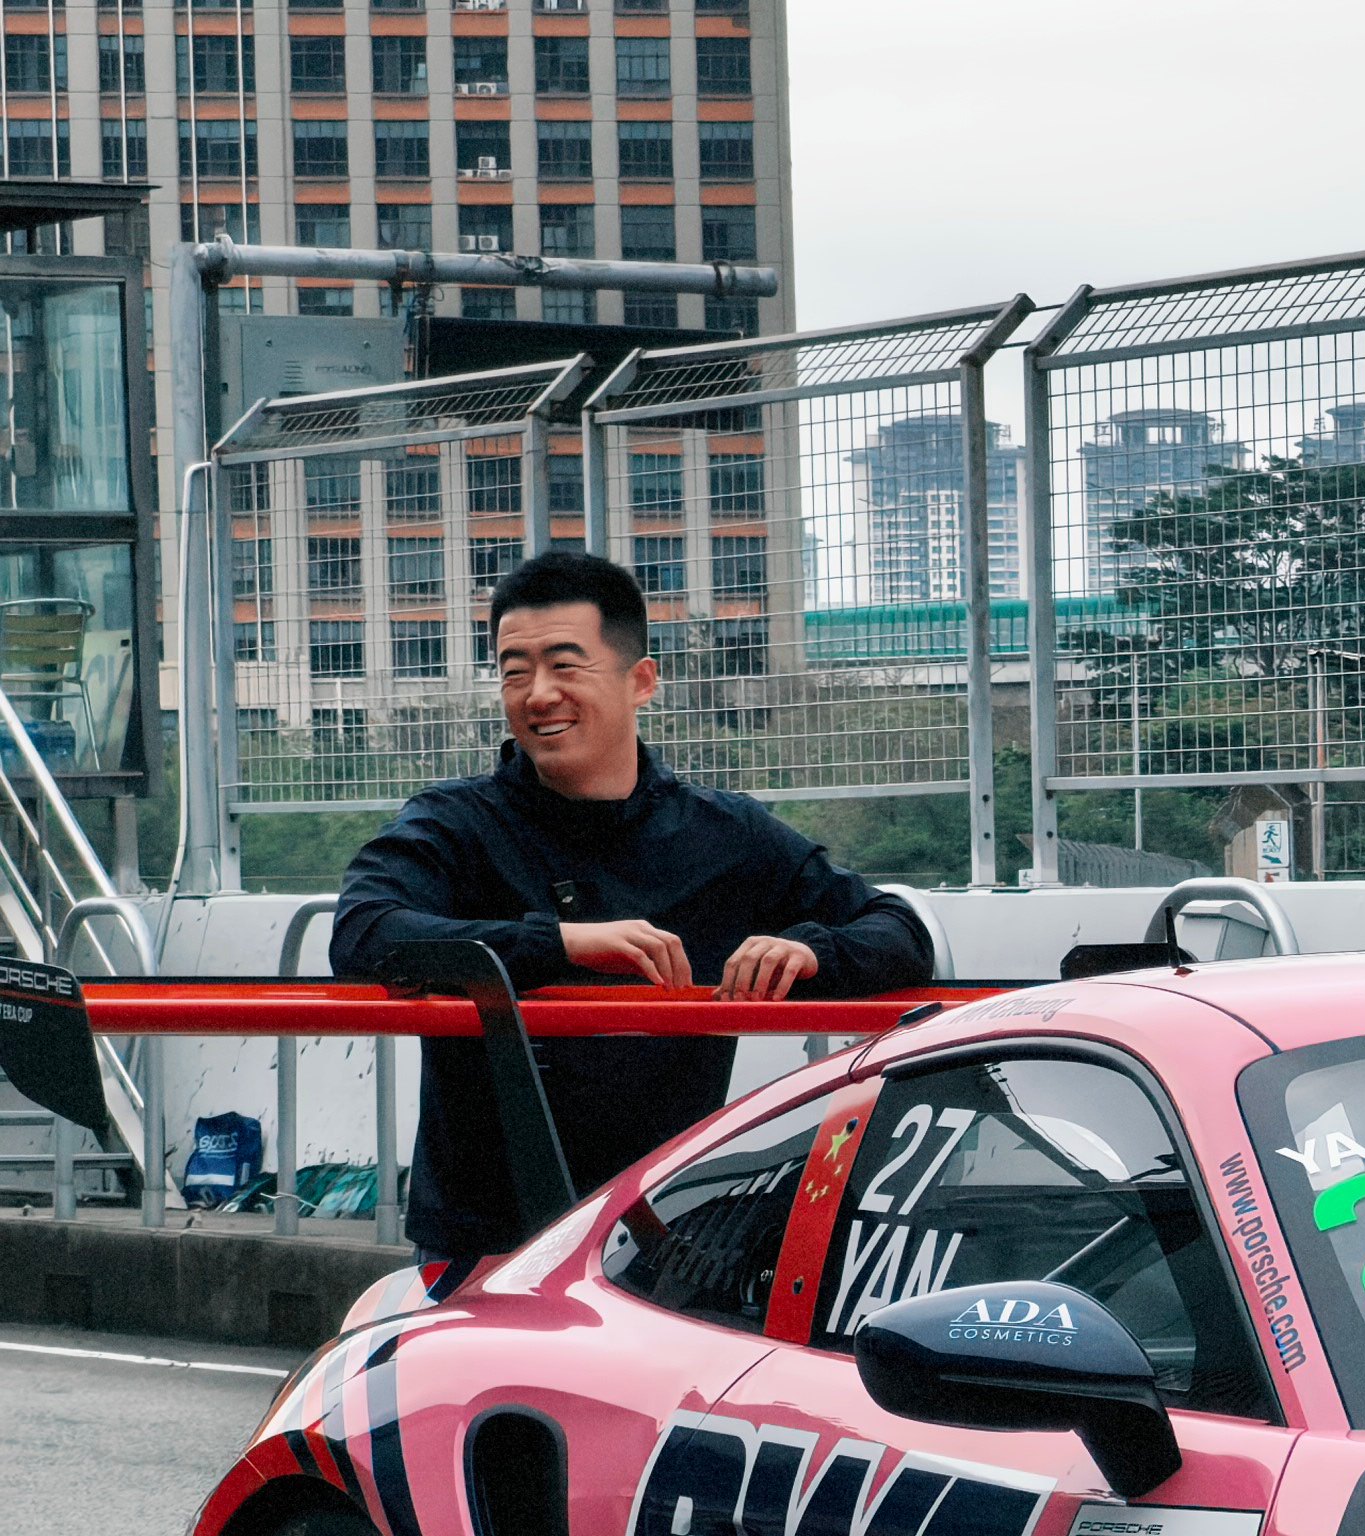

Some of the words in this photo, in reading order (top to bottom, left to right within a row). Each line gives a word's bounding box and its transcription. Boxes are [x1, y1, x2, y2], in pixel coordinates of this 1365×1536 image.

[0, 966, 72, 995] ORSCHE
[857, 1103, 977, 1216] 27
[825, 1220, 963, 1337] YAN
[1219, 1152, 1307, 1374] www.porsche.com
[951, 1299, 1078, 1330] ADA
[948, 1327, 1072, 1346] COSMETICS
[1079, 1521, 1163, 1535] PORSCHE
